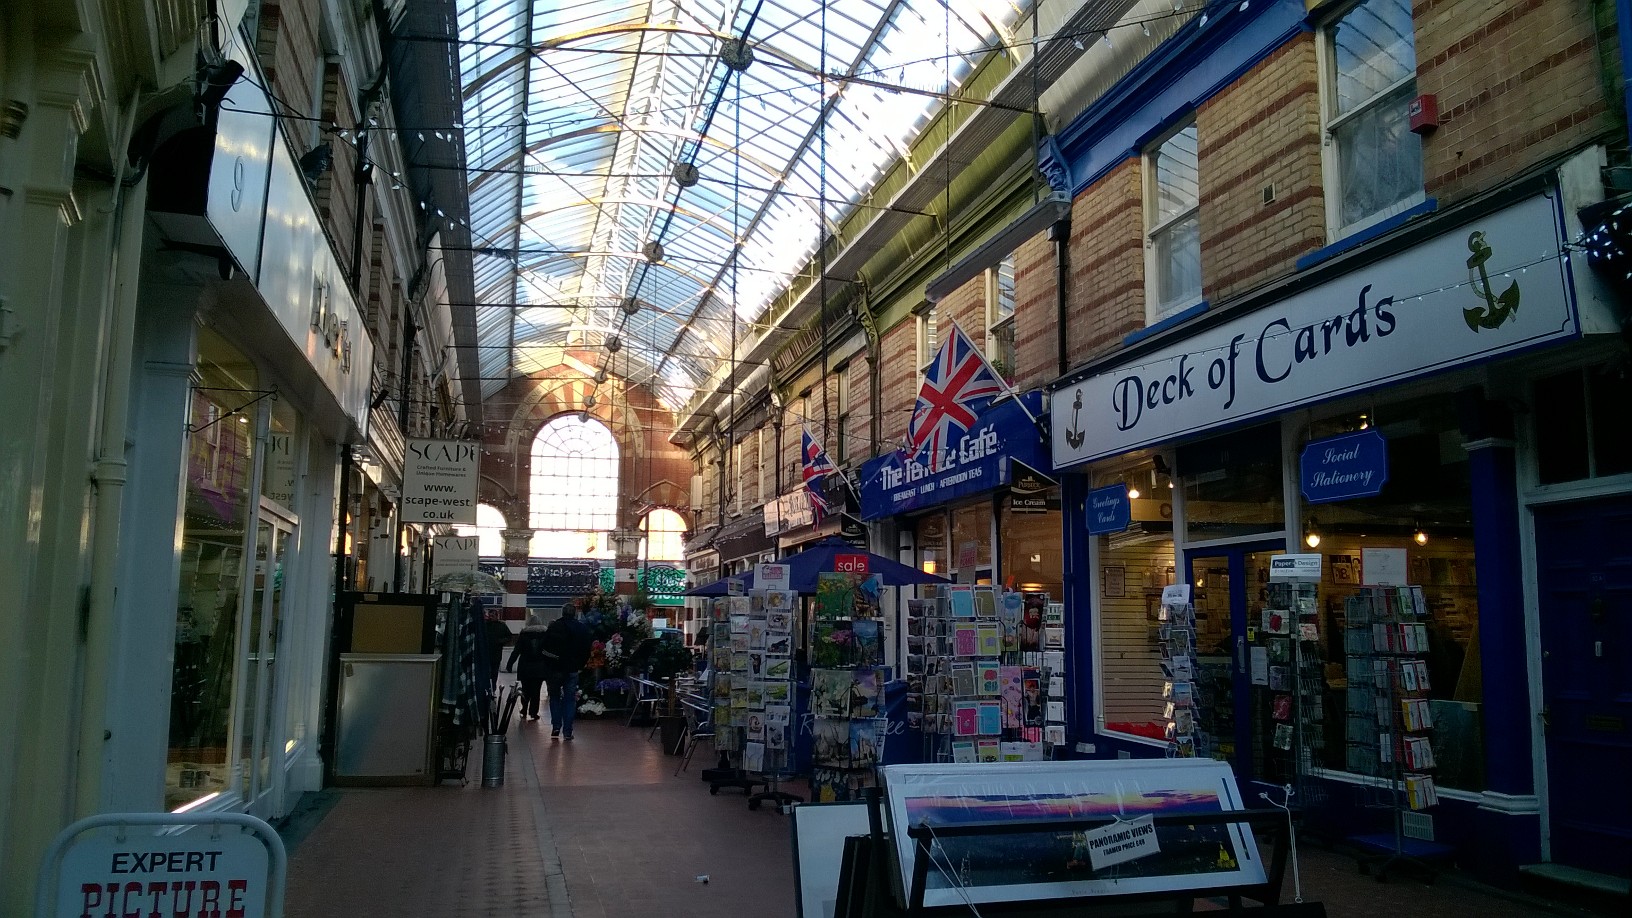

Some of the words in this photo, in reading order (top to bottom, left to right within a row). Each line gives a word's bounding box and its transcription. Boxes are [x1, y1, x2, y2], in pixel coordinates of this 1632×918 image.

[1112, 353, 1195, 432] Deck
[1207, 333, 1245, 410] of
[1255, 284, 1397, 384] Cards
[409, 441, 476, 463] SCAPE
[881, 464, 903, 491] The
[959, 422, 998, 465] Café
[1322, 443, 1360, 465] Social
[423, 483, 457, 493] www.
[920, 481, 935, 495] LUNCH
[939, 471, 968, 489] AFTERNOON
[968, 466, 983, 481] TEAS
[1310, 469, 1376, 488] Stationery
[405, 496, 474, 508] scape-west.
[422, 509, 455, 520] co.uk
[837, 556, 866, 572] sale
[1089, 830, 1131, 850] PANORAMIC
[1130, 823, 1154, 838] VIEWS
[1102, 845, 1122, 856] FRAMED
[1122, 841, 1136, 851] PRICE
[111, 851, 223, 874] EXPERT
[80, 879, 248, 918] PICTURE
